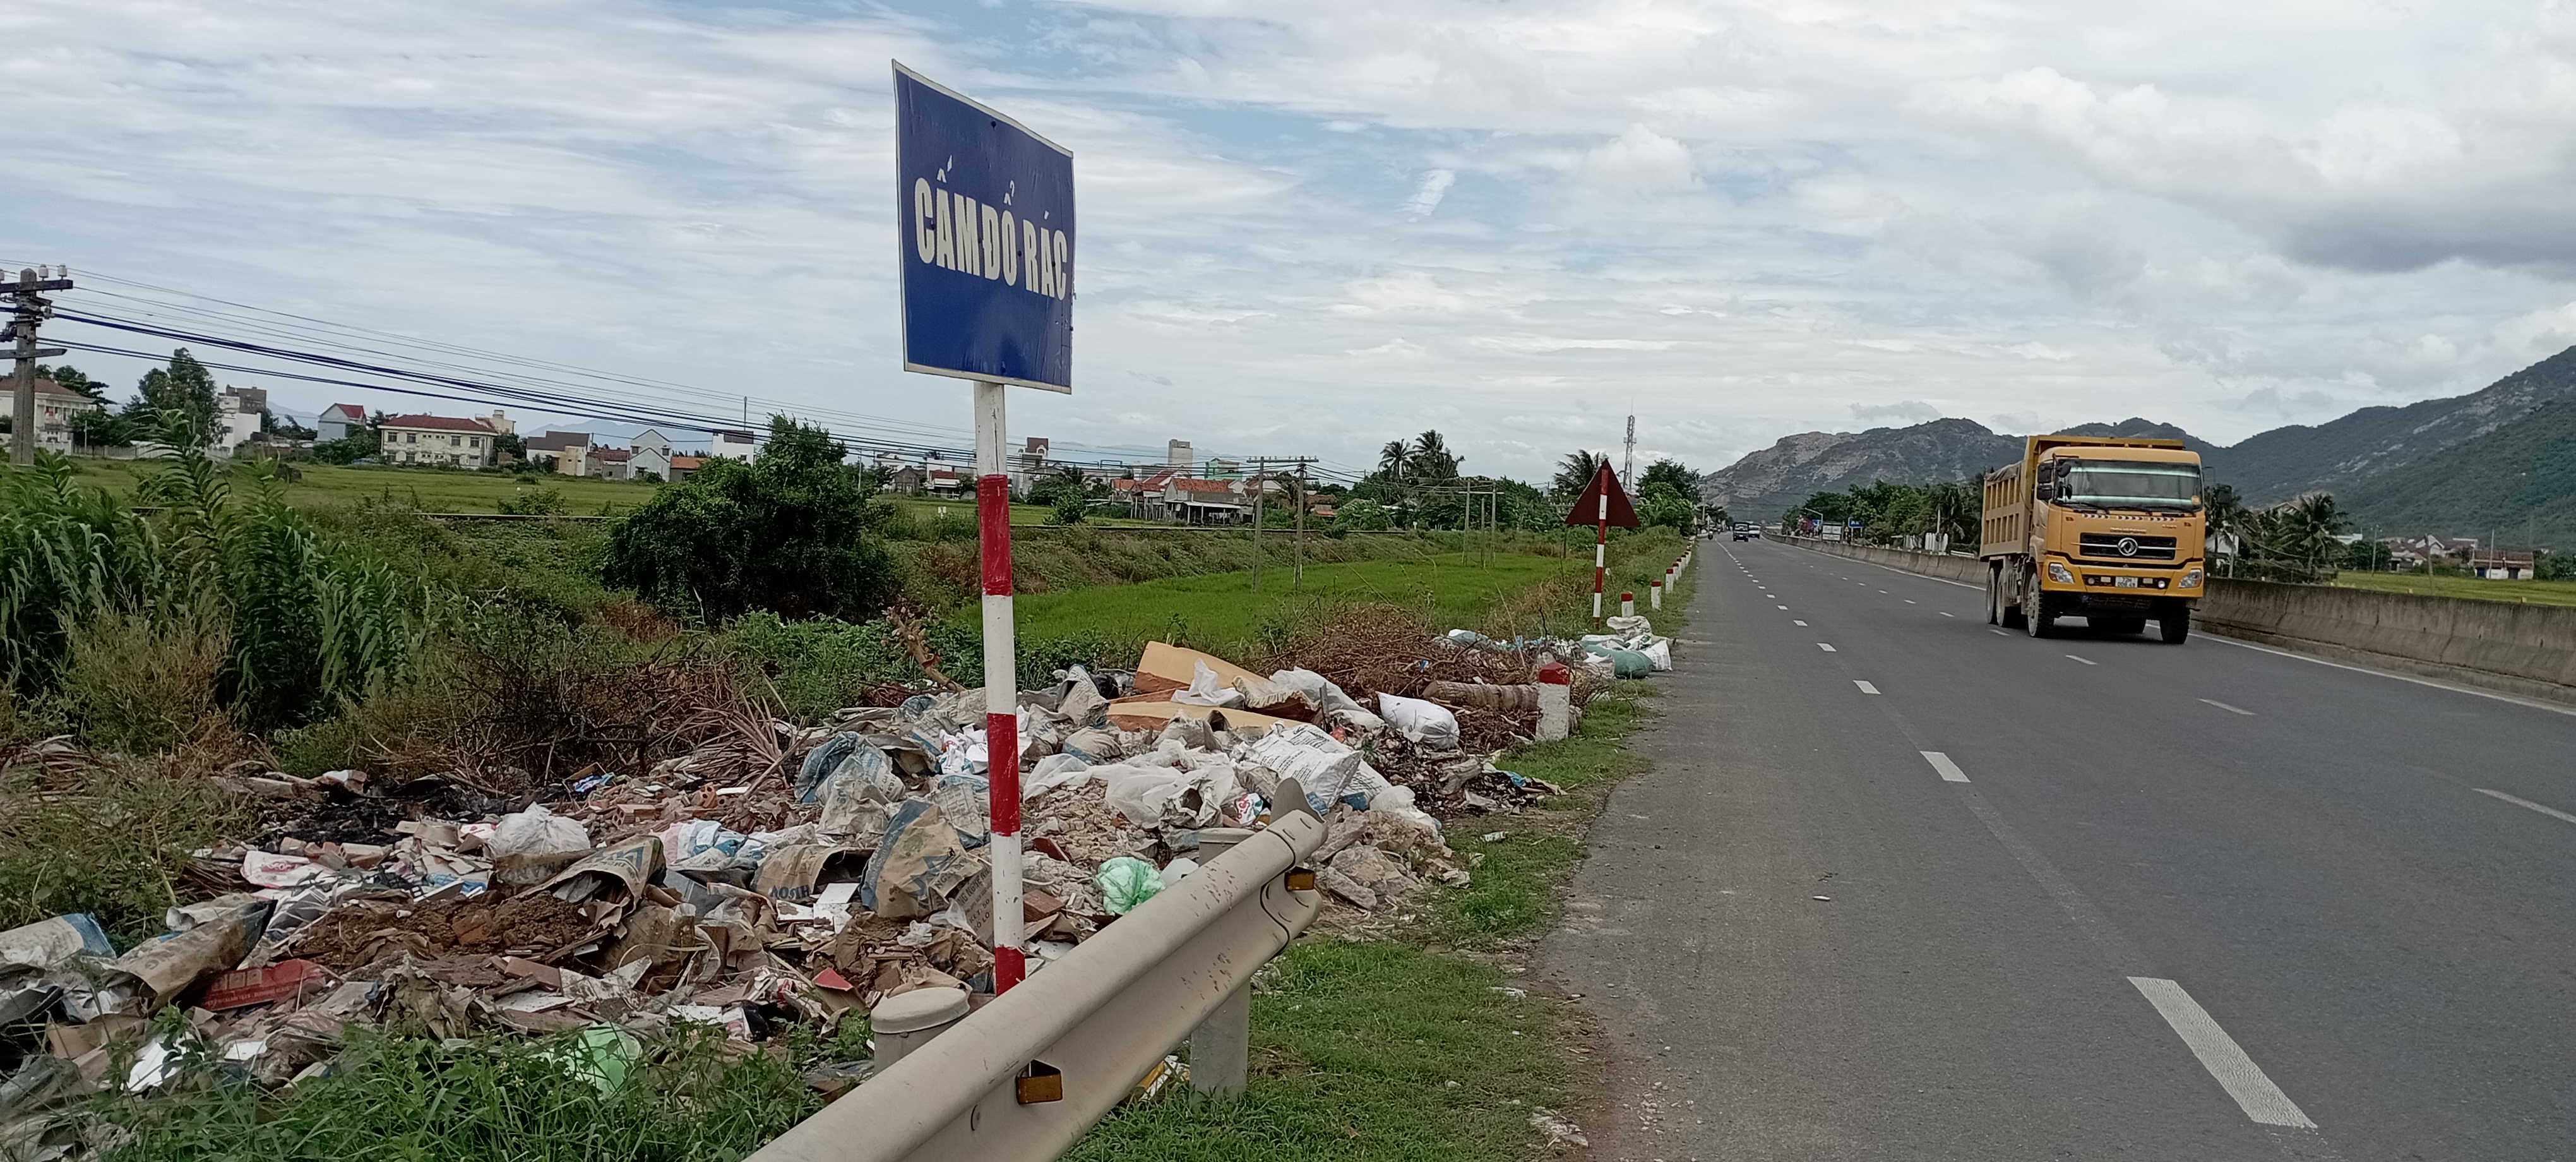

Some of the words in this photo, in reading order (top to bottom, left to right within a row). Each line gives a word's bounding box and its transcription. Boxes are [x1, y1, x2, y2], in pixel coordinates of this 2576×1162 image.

[915, 155, 980, 276] CẤM
[982, 180, 1017, 286] ĐỔ
[1023, 210, 1067, 301] RÁC
